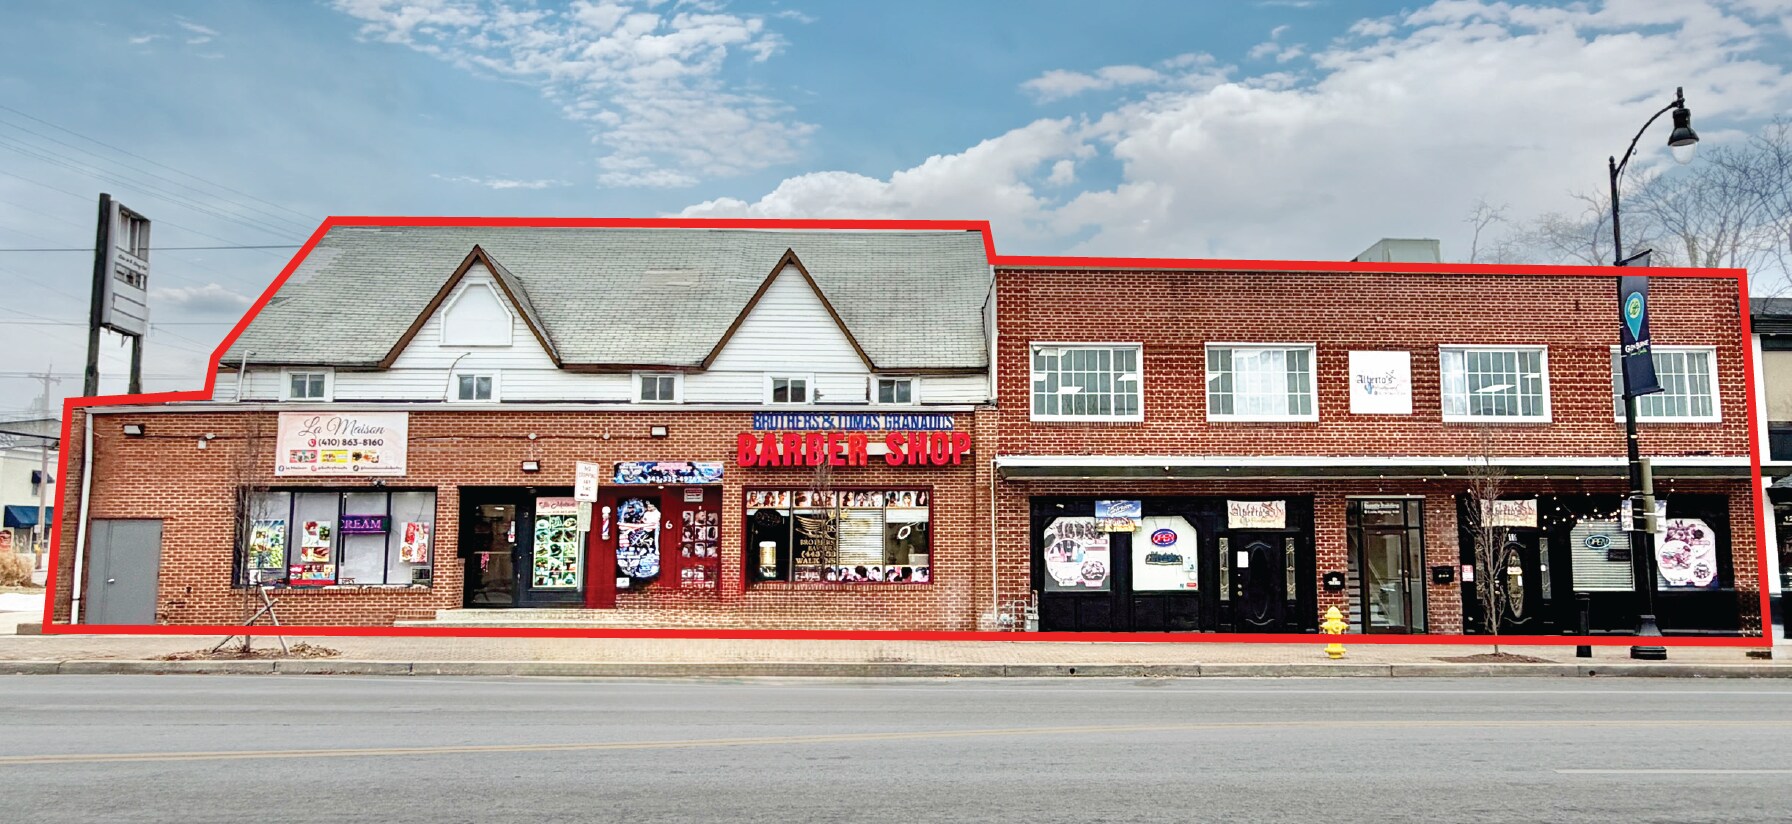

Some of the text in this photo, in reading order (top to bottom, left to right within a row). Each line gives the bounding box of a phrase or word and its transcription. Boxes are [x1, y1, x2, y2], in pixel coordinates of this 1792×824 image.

[298, 416, 385, 438] La Maison
[754, 414, 819, 430] BROTHERS
[821, 414, 836, 430] &
[318, 438, 384, 447] (410) 863-8160
[737, 432, 972, 467] BARBER SHOP
[665, 520, 673, 530] 6
[1153, 532, 1175, 544] OPEN
[1587, 537, 1609, 546] OPEN
